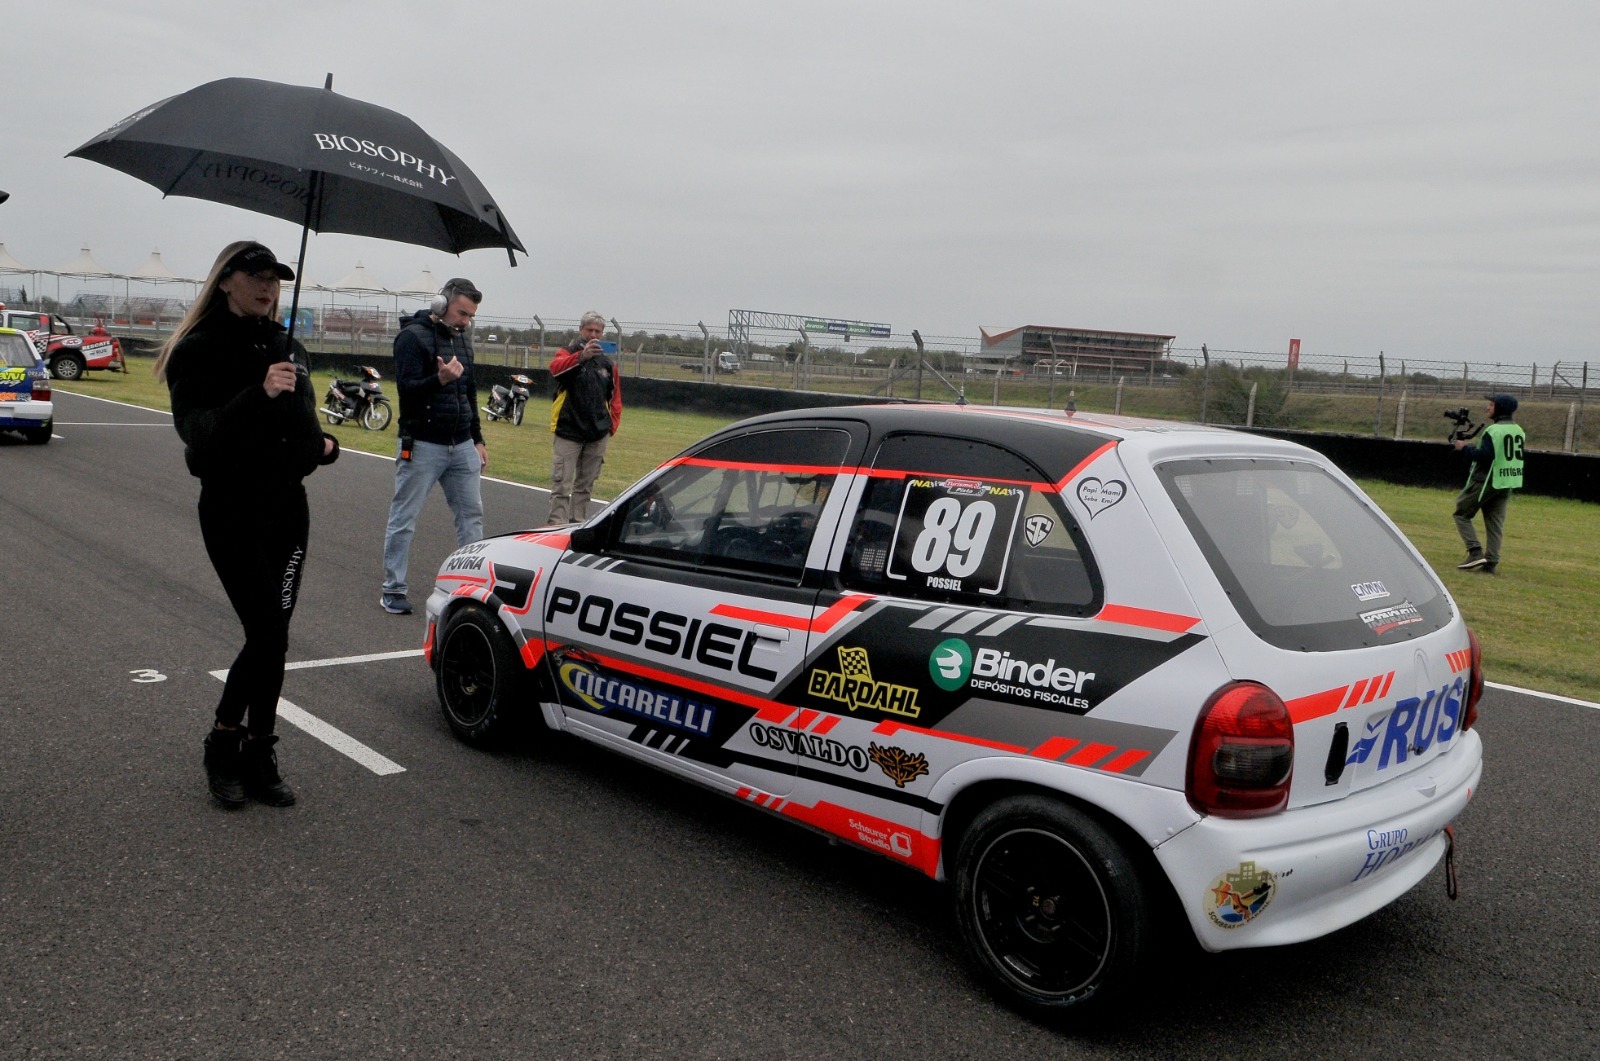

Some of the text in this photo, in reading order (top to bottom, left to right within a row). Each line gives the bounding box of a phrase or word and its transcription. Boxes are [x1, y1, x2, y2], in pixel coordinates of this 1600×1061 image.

[313, 133, 457, 187] BIOSOPHY
[1503, 433, 1524, 461] 03
[1083, 486, 1121, 497] Papi Mami
[911, 497, 997, 578] 89
[281, 545, 303, 609] BIOSOPHY
[926, 576, 962, 592] POSSIEL
[545, 587, 778, 683] POSSIEL
[808, 669, 921, 718] BARDAHL
[970, 678, 1089, 709] DEPÓSITOS FISCALES
[972, 647, 1095, 694] Binder
[574, 670, 712, 734] CICCARELLI
[1377, 676, 1463, 771] RUS
[750, 723, 869, 773] OSVALDO
[849, 818, 888, 840] Scheurer
[858, 831, 890, 851] Studio
[1208, 910, 1236, 930] SOMBRAS
